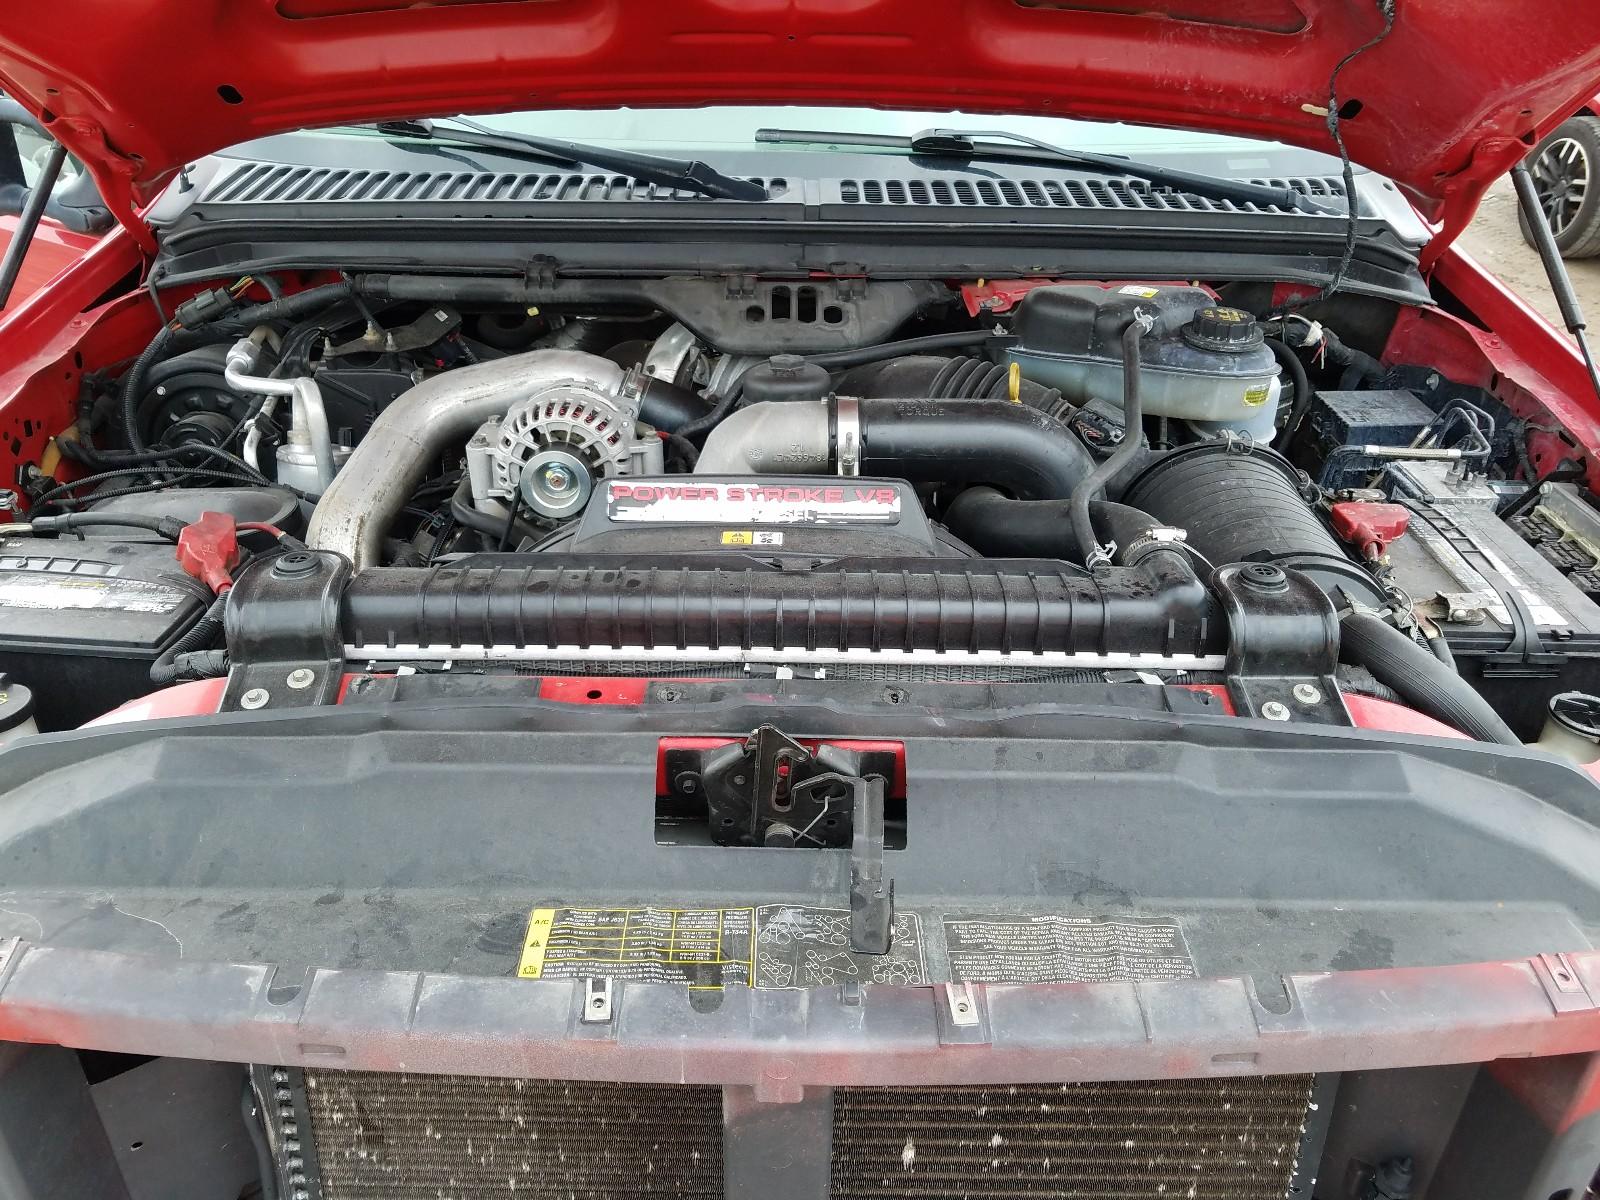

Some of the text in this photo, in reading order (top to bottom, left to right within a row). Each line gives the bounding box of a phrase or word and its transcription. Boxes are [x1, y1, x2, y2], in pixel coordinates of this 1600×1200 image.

[612, 485, 896, 504] POWER STROKE V8
